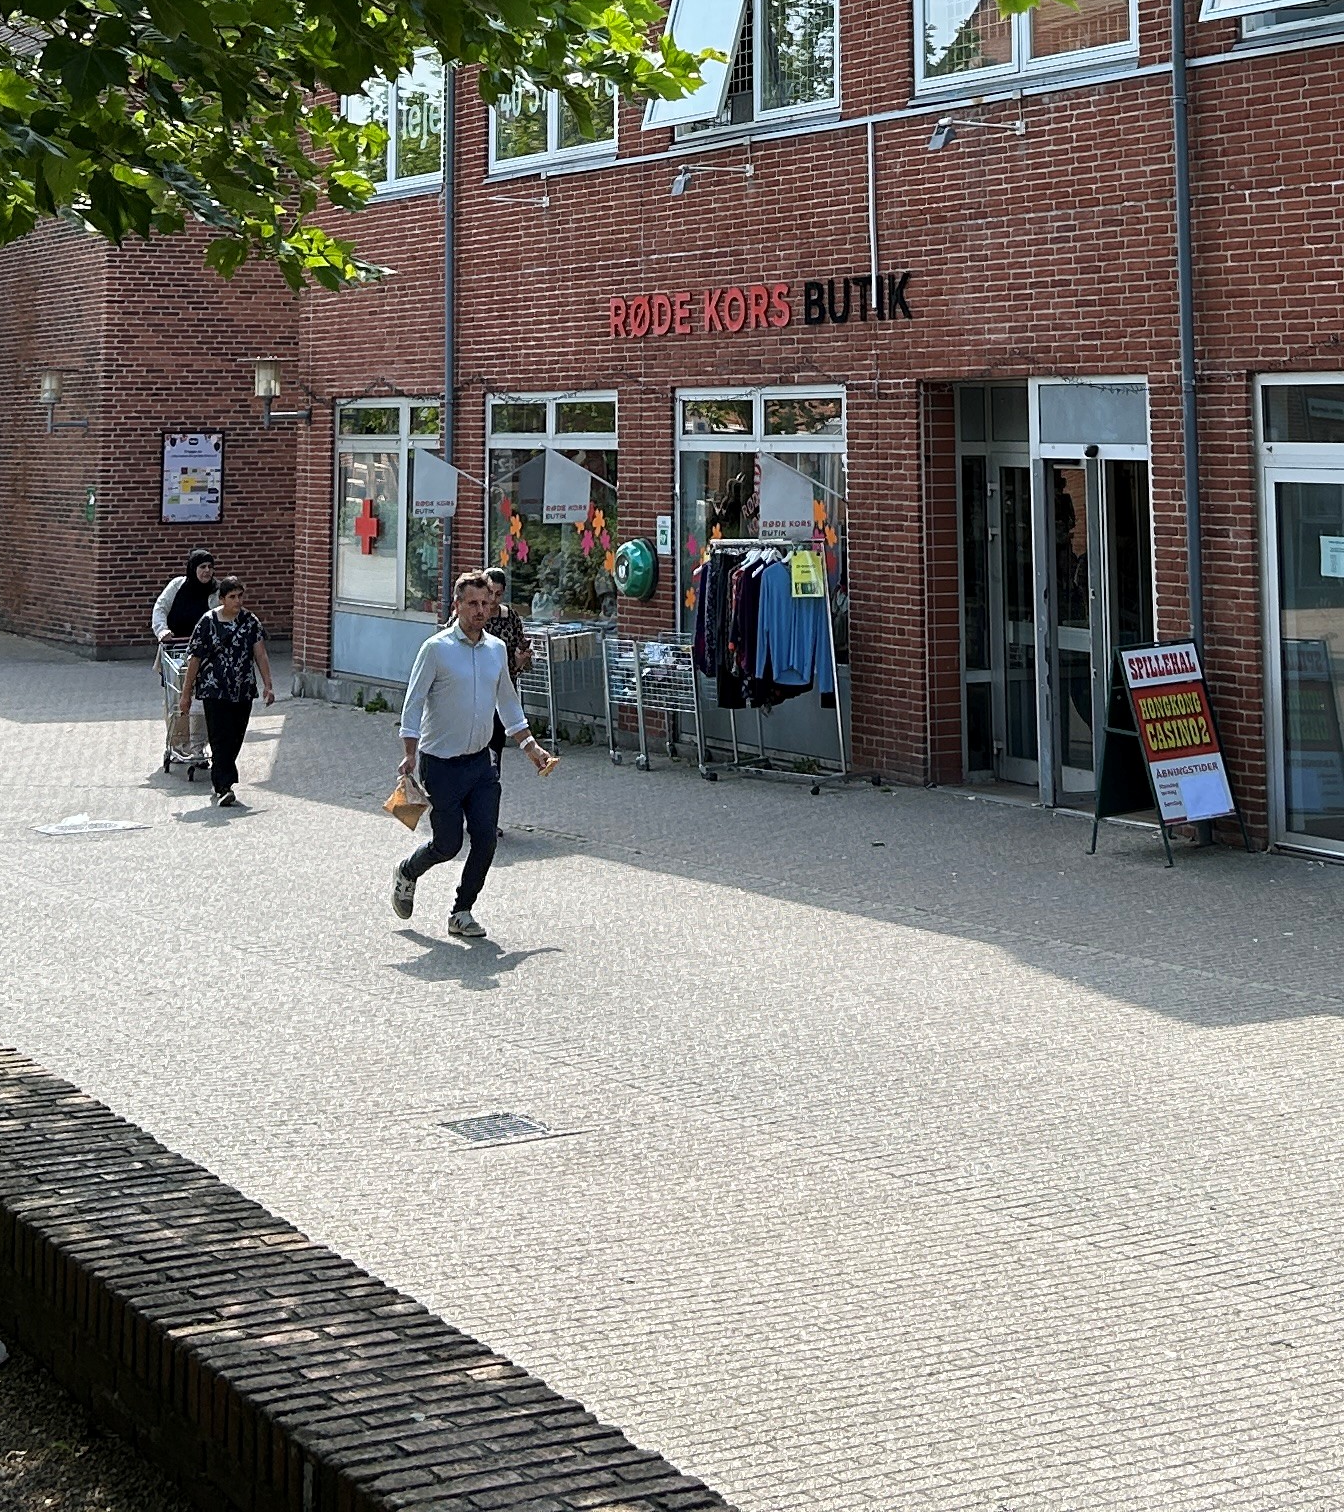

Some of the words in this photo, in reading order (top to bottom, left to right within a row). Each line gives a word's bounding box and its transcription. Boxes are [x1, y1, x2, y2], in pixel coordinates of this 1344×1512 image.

[609, 293, 692, 337] RØDE
[704, 283, 791, 332] KORS
[804, 273, 912, 325] BUTIK
[761, 529, 787, 537] BUTIK
[762, 520, 787, 528] RØDE
[789, 520, 812, 528] KORS
[1128, 651, 1197, 680] SPILLEHAL
[1138, 692, 1202, 720] HONGKONG
[1156, 762, 1219, 779] ÅBNINGSTIDER
